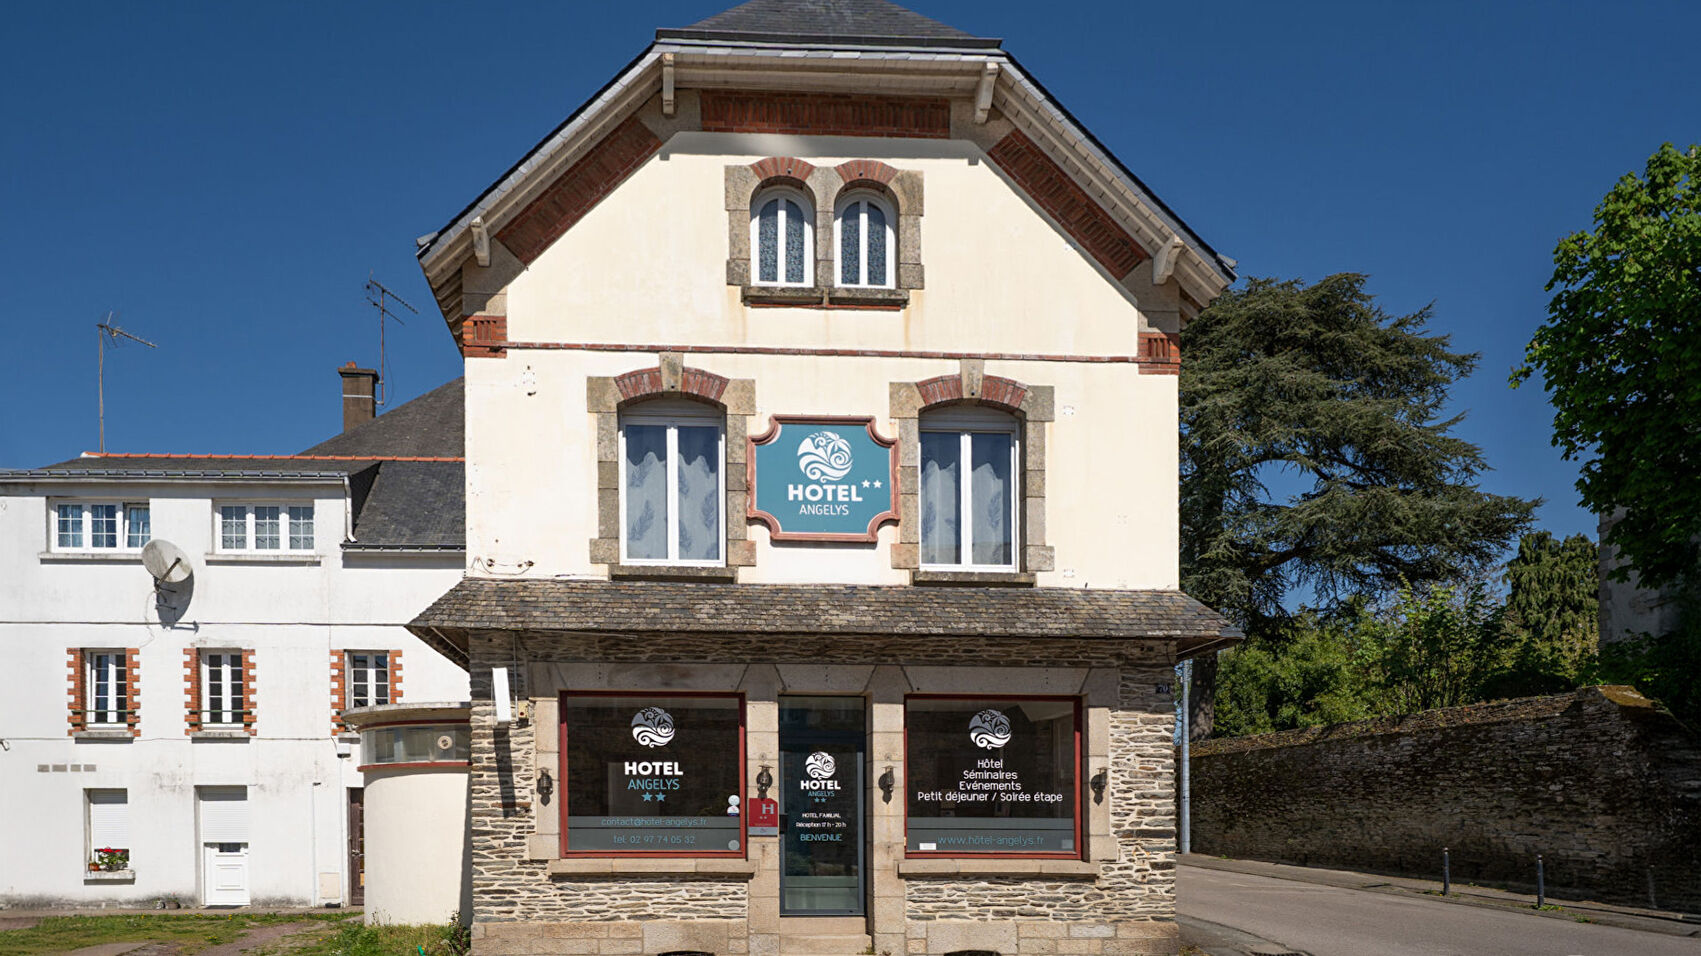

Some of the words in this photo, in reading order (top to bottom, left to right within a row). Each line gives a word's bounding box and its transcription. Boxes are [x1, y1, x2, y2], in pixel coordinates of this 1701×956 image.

[788, 484, 863, 501] HOTEL
[799, 504, 849, 515] ANGELYS
[624, 761, 684, 776] HOTEL
[977, 759, 1004, 769] Hôtel
[963, 770, 1018, 780] Séminaires
[627, 778, 680, 790] ANGELYS
[800, 780, 841, 790] HOTEL
[959, 781, 1022, 791] Evénements
[917, 791, 943, 801] Petit
[945, 791, 989, 804] déjeuner
[991, 792, 998, 801] /
[1000, 791, 1031, 802] Soirée
[1033, 791, 1063, 804] étape
[761, 803, 775, 815] H
[630, 835, 641, 844] 02
[800, 833, 843, 842] BIENVENUE
